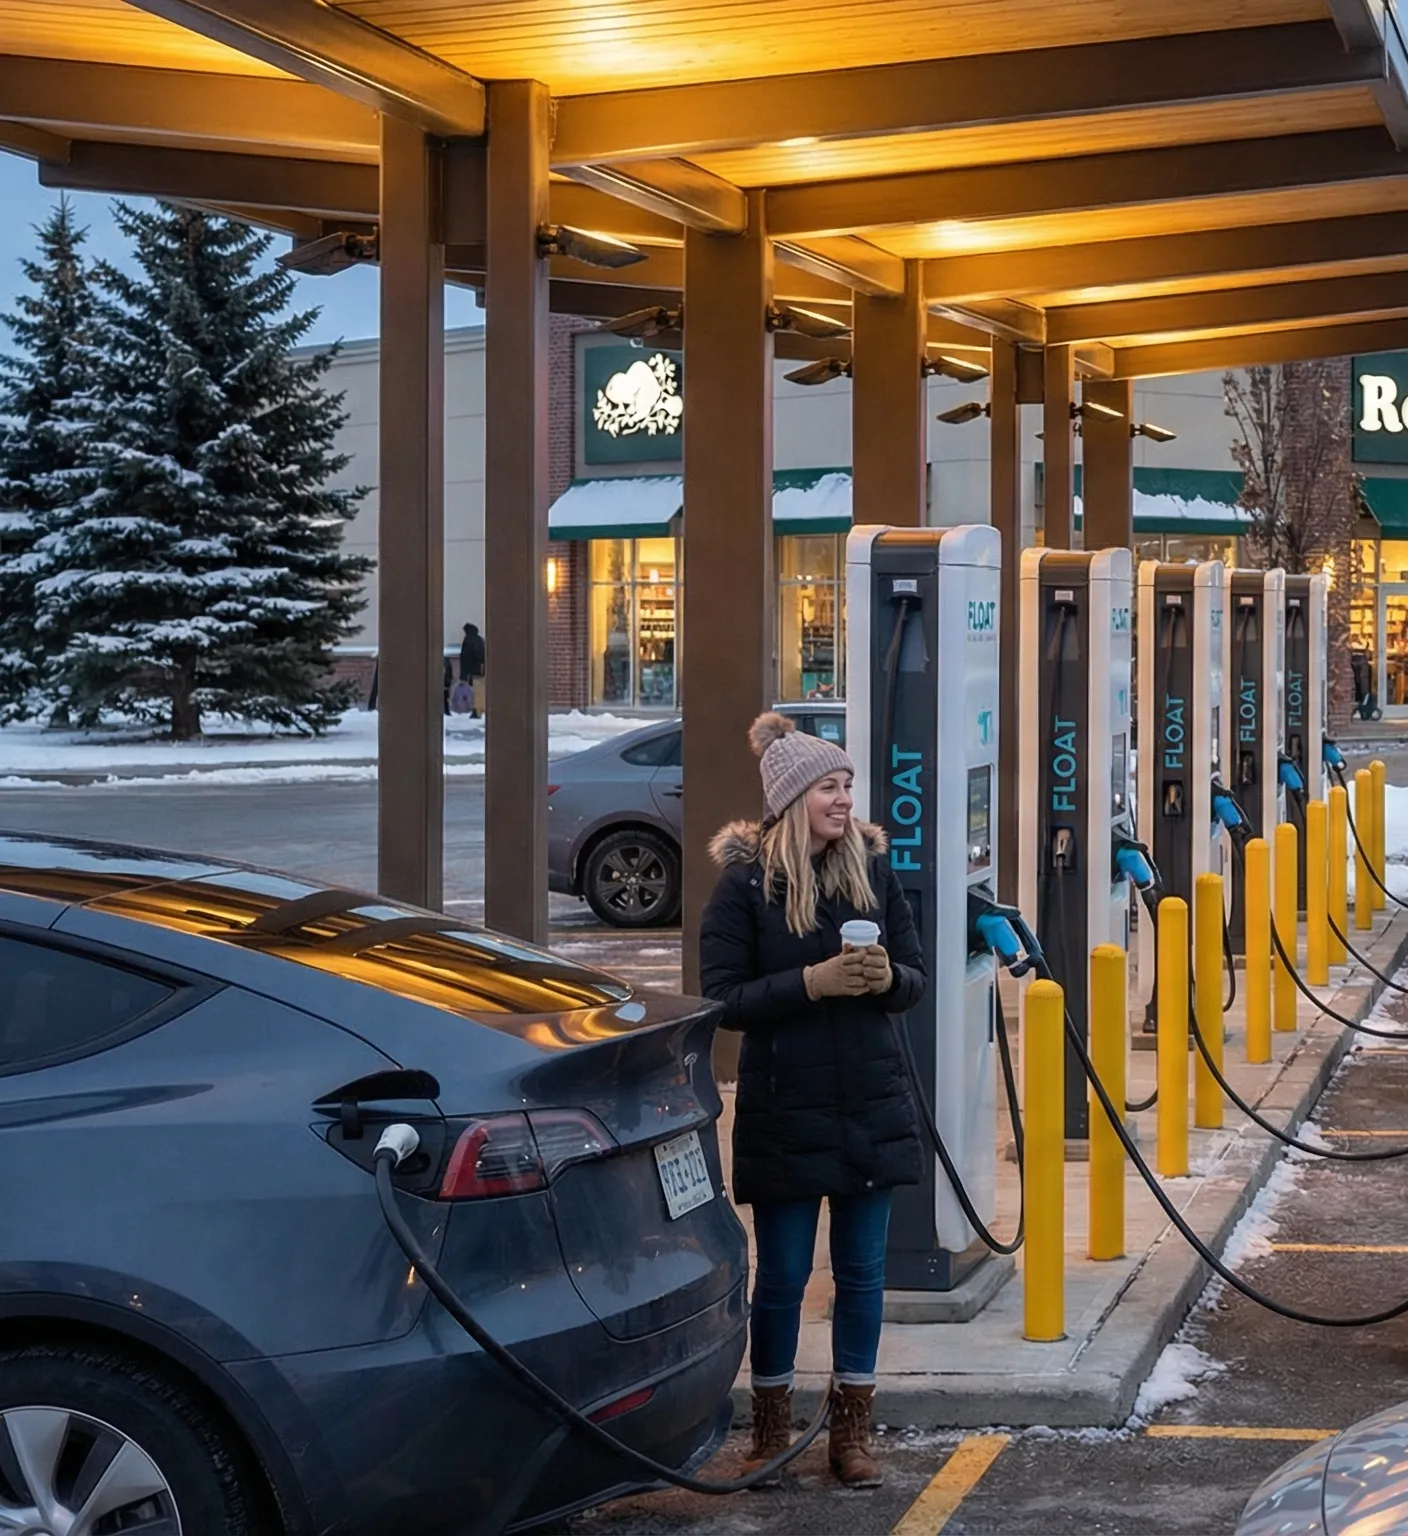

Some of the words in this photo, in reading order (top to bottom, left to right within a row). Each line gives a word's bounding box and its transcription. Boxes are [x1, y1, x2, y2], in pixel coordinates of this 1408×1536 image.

[1164, 693, 1185, 769] FLOAT
[1240, 678, 1256, 742] FLOAT
[1288, 669, 1303, 727] FLOAT
[1053, 715, 1076, 811] FLOAT
[891, 744, 922, 871] FLOAT
